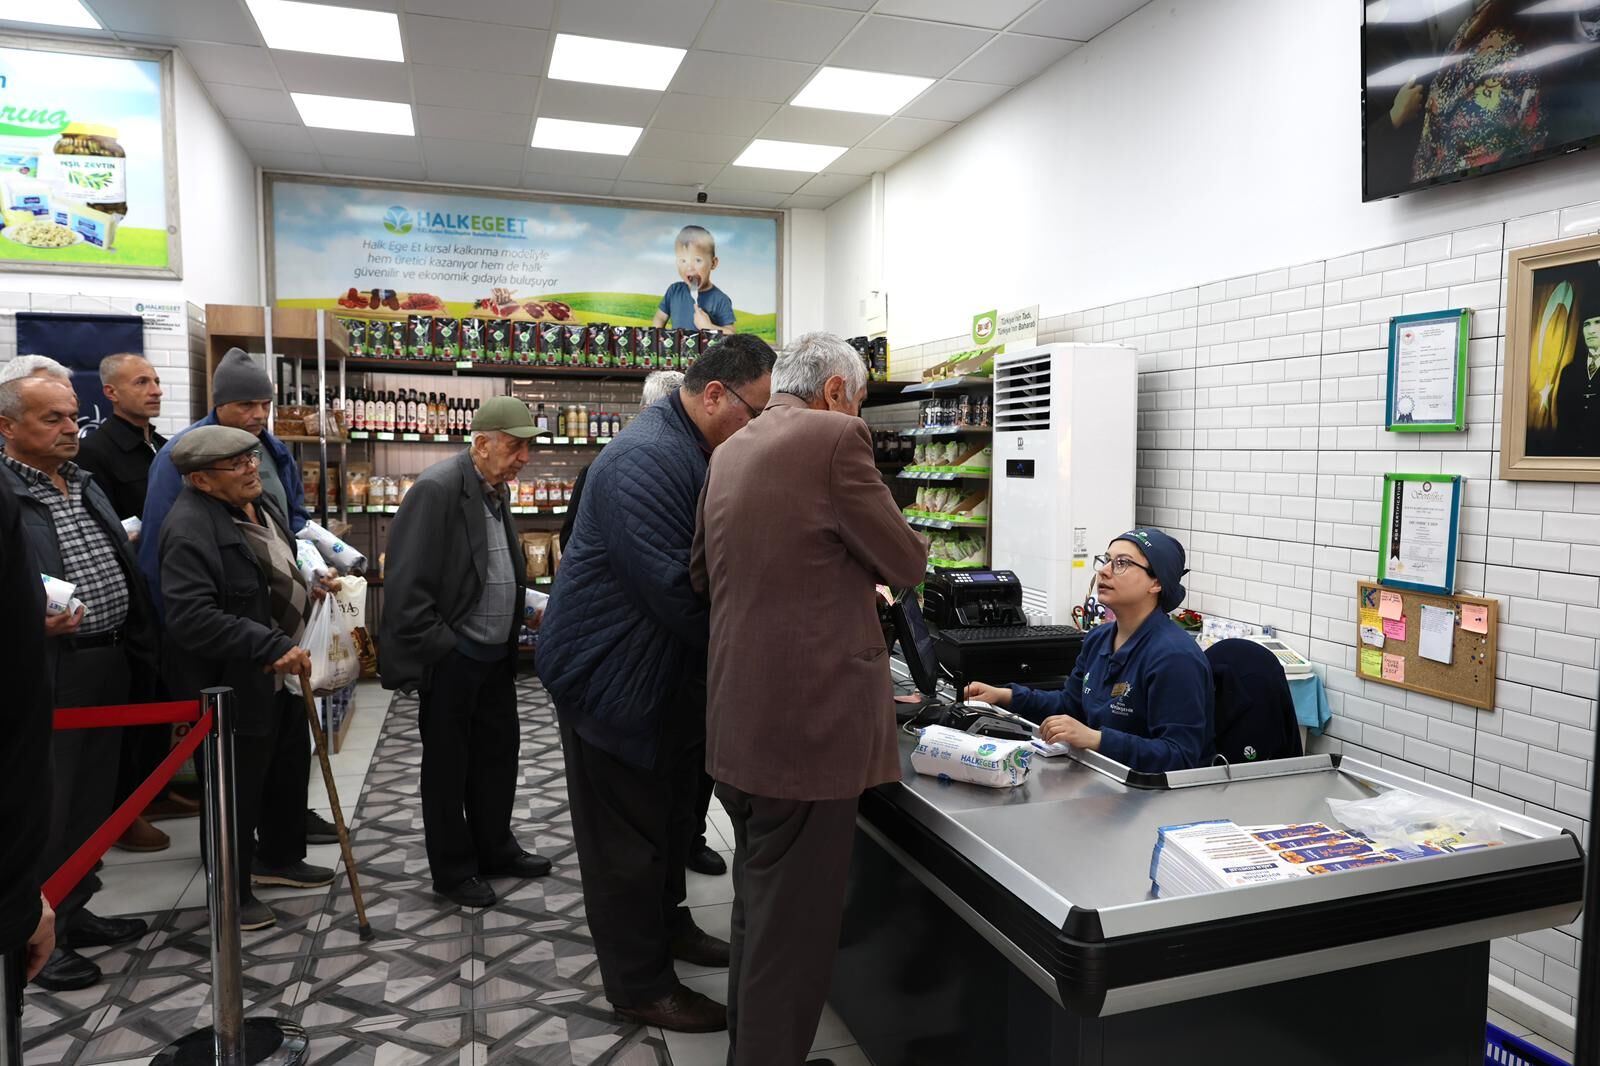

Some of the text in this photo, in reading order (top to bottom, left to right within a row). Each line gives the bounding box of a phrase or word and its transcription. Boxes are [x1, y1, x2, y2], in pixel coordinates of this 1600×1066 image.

[417, 211, 528, 233] HALKEGEET
[362, 240, 550, 261] Halk Ege Et kırsal kalkınma modeliyle
[367, 252, 543, 273] hem üretici kazanıyor hem de halk
[353, 266, 401, 279] güvenilir
[403, 270, 416, 279] ve
[418, 270, 469, 281] ekonomik
[471, 273, 507, 286] gıdayla
[960, 754, 1000, 769] HALKEGEET
